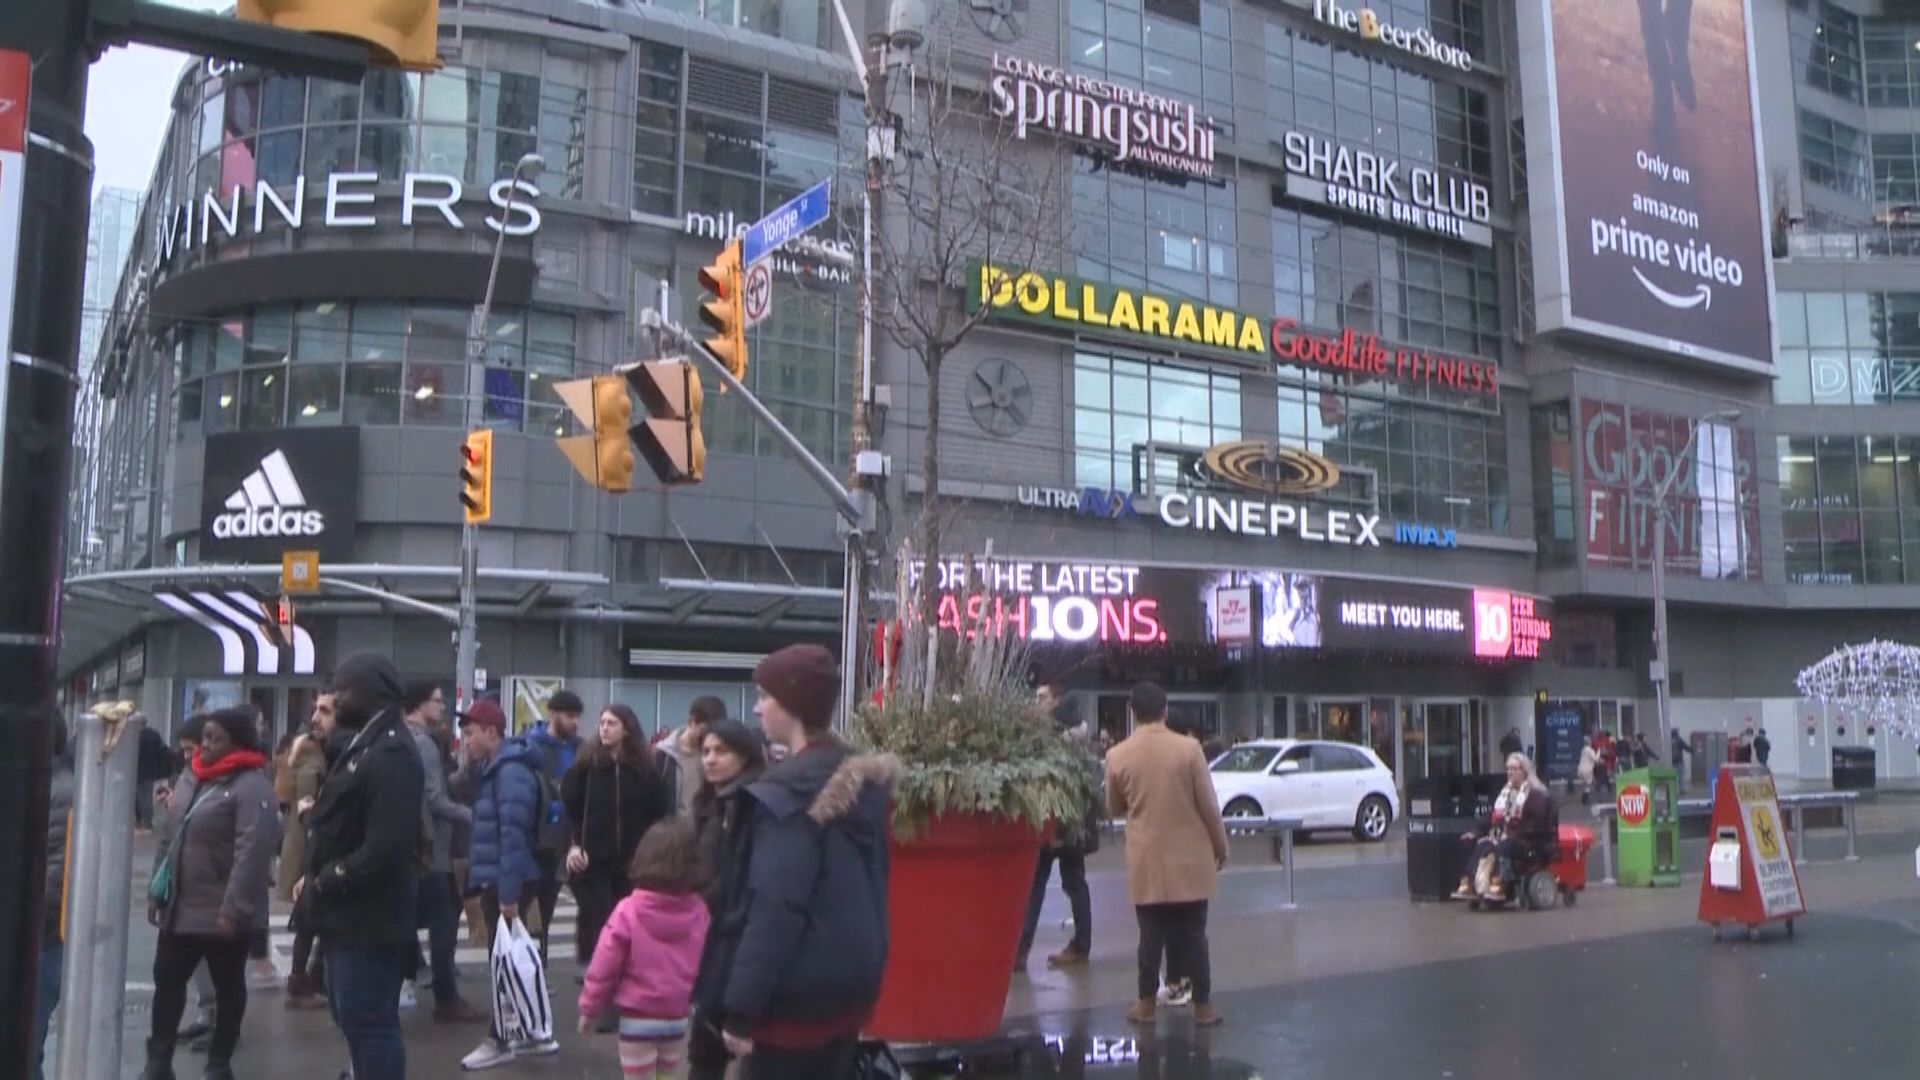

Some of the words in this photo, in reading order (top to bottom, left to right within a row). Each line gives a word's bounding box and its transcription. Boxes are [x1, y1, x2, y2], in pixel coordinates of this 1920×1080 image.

[994, 52, 1065, 84] LOUNGE
[1076, 74, 1181, 117] RESTAURANT
[1284, 131, 1400, 199] SHARK
[1411, 167, 1491, 223] CLUB
[1636, 149, 1669, 182] Only
[1672, 166, 1690, 184] on
[155, 171, 542, 272] WINNERS
[762, 211, 798, 245] Yonge
[1327, 184, 1386, 217] SPORTS
[1391, 202, 1421, 228] BAR
[1427, 211, 1465, 237] GRILL
[1632, 193, 1700, 230] amazon
[1591, 216, 1670, 268] prime
[1673, 238, 1744, 287] video
[980, 264, 1266, 354] DOLLARAMA
[1394, 347, 1498, 396] FITNESS
[212, 505, 325, 538] adidas
[1159, 493, 1381, 548] CINEPLEX
[1393, 521, 1458, 549] IMAX
[1041, 563, 1140, 595] LATEST
[1341, 601, 1388, 627] MEET
[1390, 604, 1421, 629] YOU
[1424, 607, 1465, 632] HERE.
[1477, 602, 1509, 643] 10
[1511, 596, 1535, 617] TEN
[1512, 616, 1552, 641] DUNDAS
[1513, 636, 1540, 658] EAST
[1620, 794, 1647, 817] NOW
